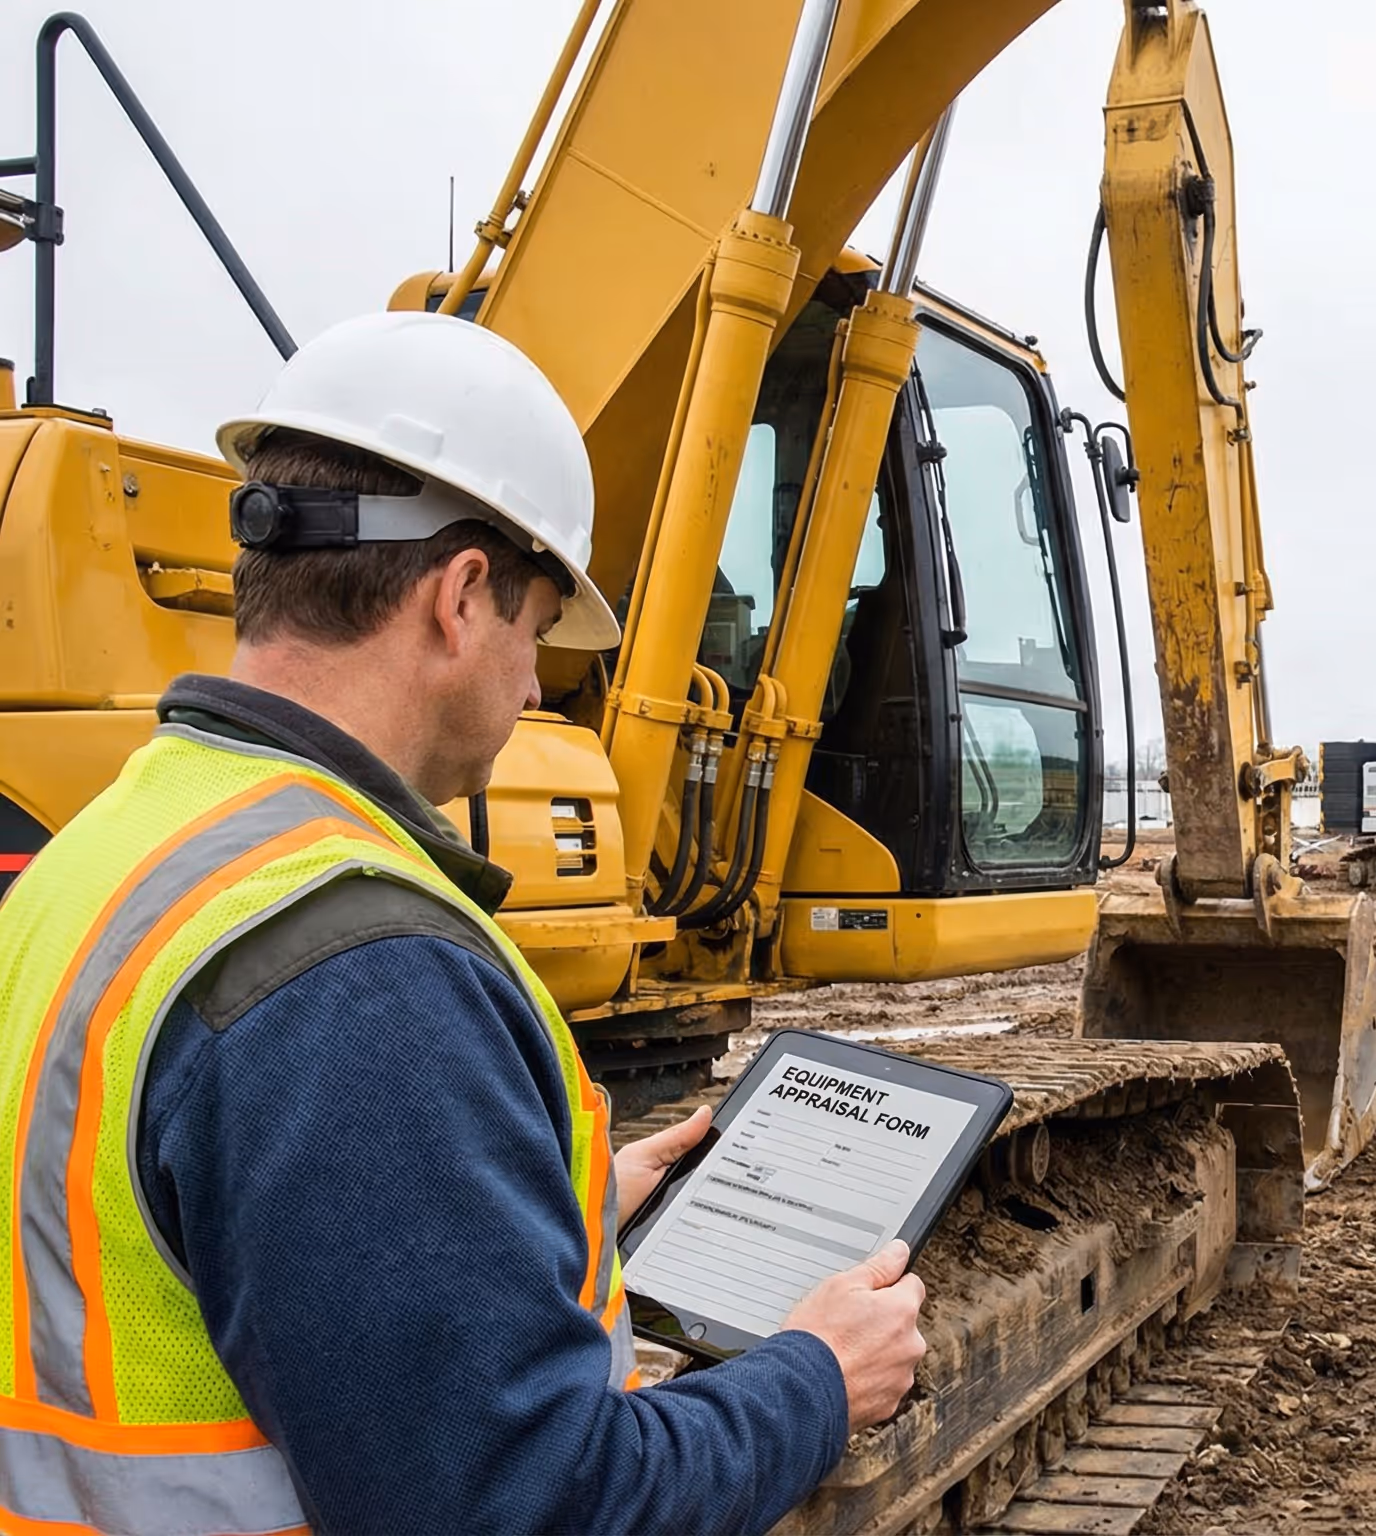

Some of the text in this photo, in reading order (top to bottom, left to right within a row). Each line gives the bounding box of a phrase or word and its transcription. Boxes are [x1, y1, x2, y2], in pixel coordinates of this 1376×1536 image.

[782, 1066, 889, 1106] EQUIPMENT
[768, 1084, 930, 1139] APPRAISAL FORM
